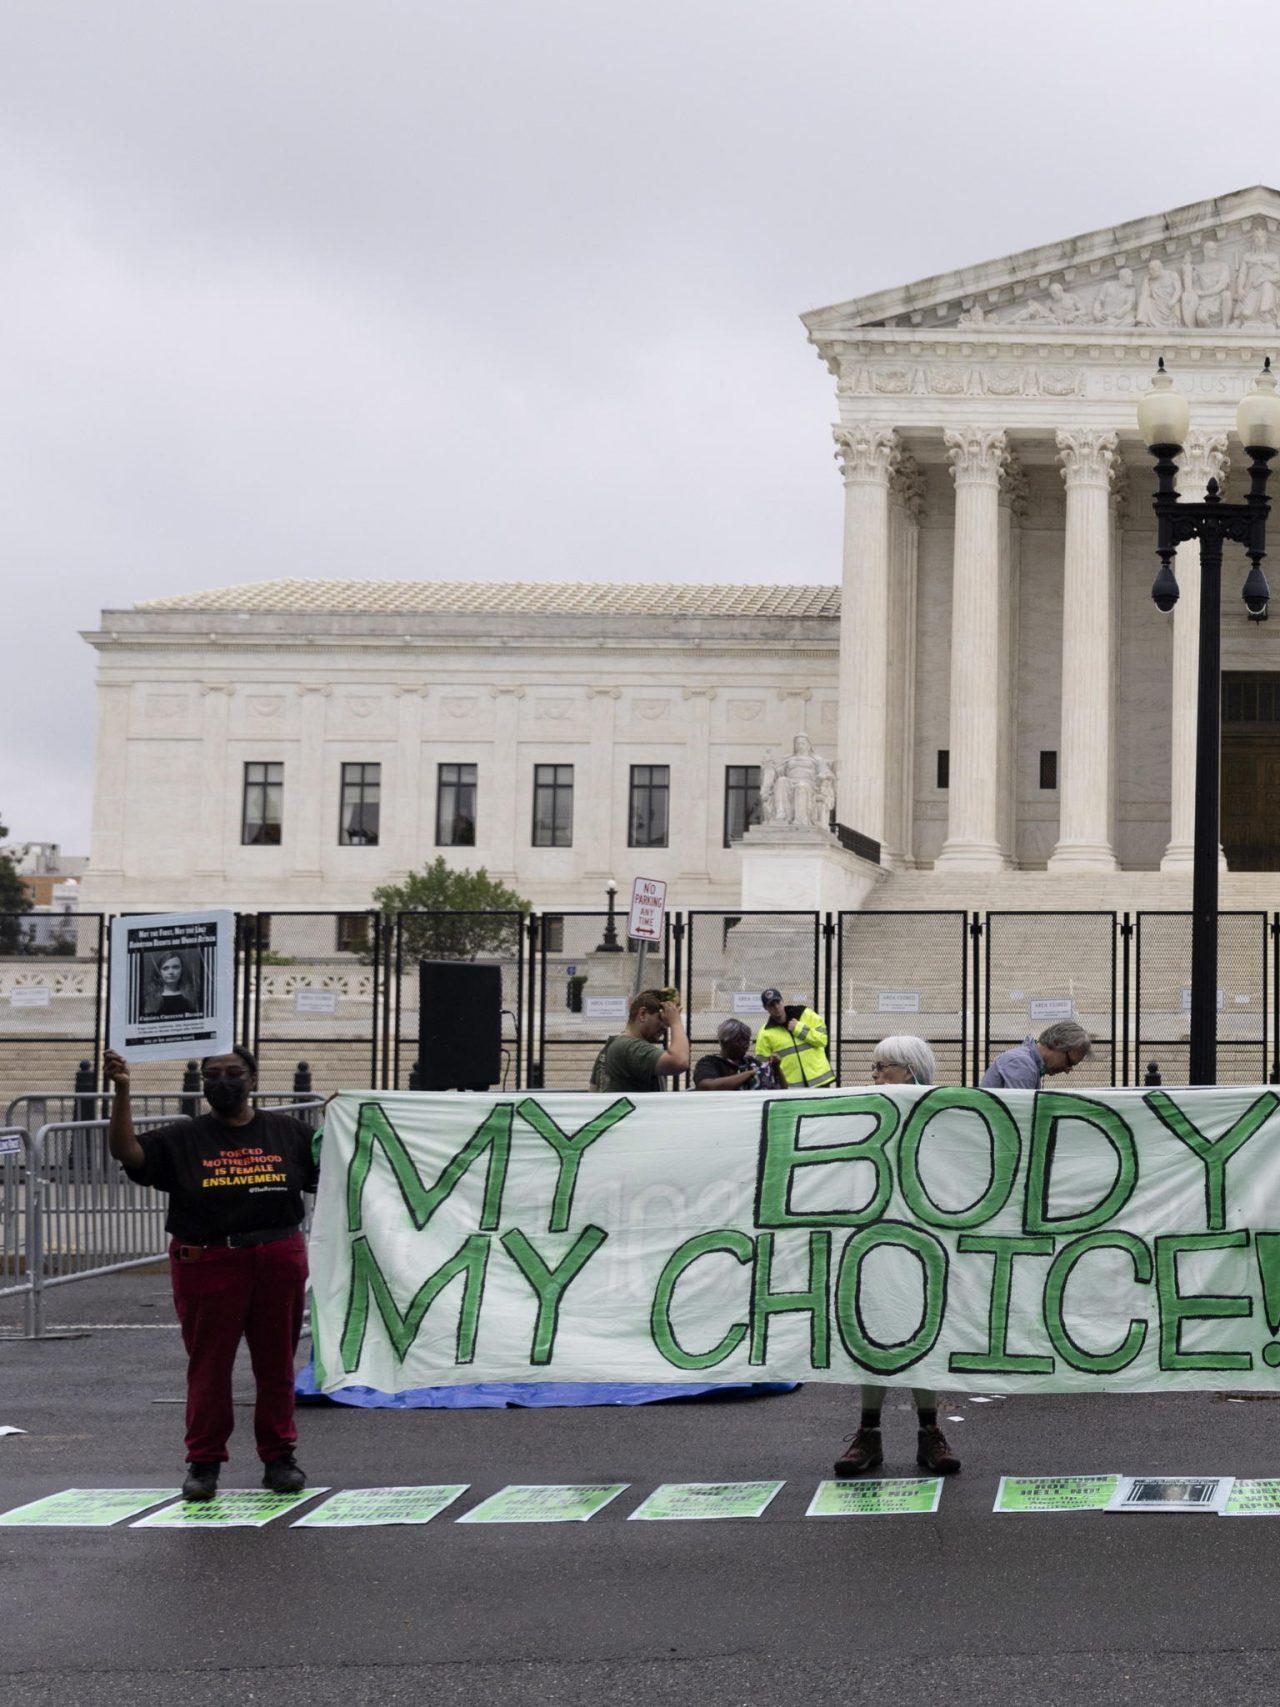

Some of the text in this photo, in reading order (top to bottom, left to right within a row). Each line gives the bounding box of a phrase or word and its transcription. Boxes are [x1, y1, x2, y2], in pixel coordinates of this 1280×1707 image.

[643, 883, 656, 894] NO
[635, 894, 662, 908] PARKING
[641, 908, 654, 916] ANY
[639, 917, 654, 926] TIME
[220, 1147, 263, 1157] FORCED
[202, 1155, 282, 1168] MOTHERHOOD
[347, 1094, 636, 1233] MY
[215, 1164, 274, 1175] IS FEMALE
[202, 1173, 287, 1188] ENSLAVEMENT
[341, 1222, 611, 1374] MY
